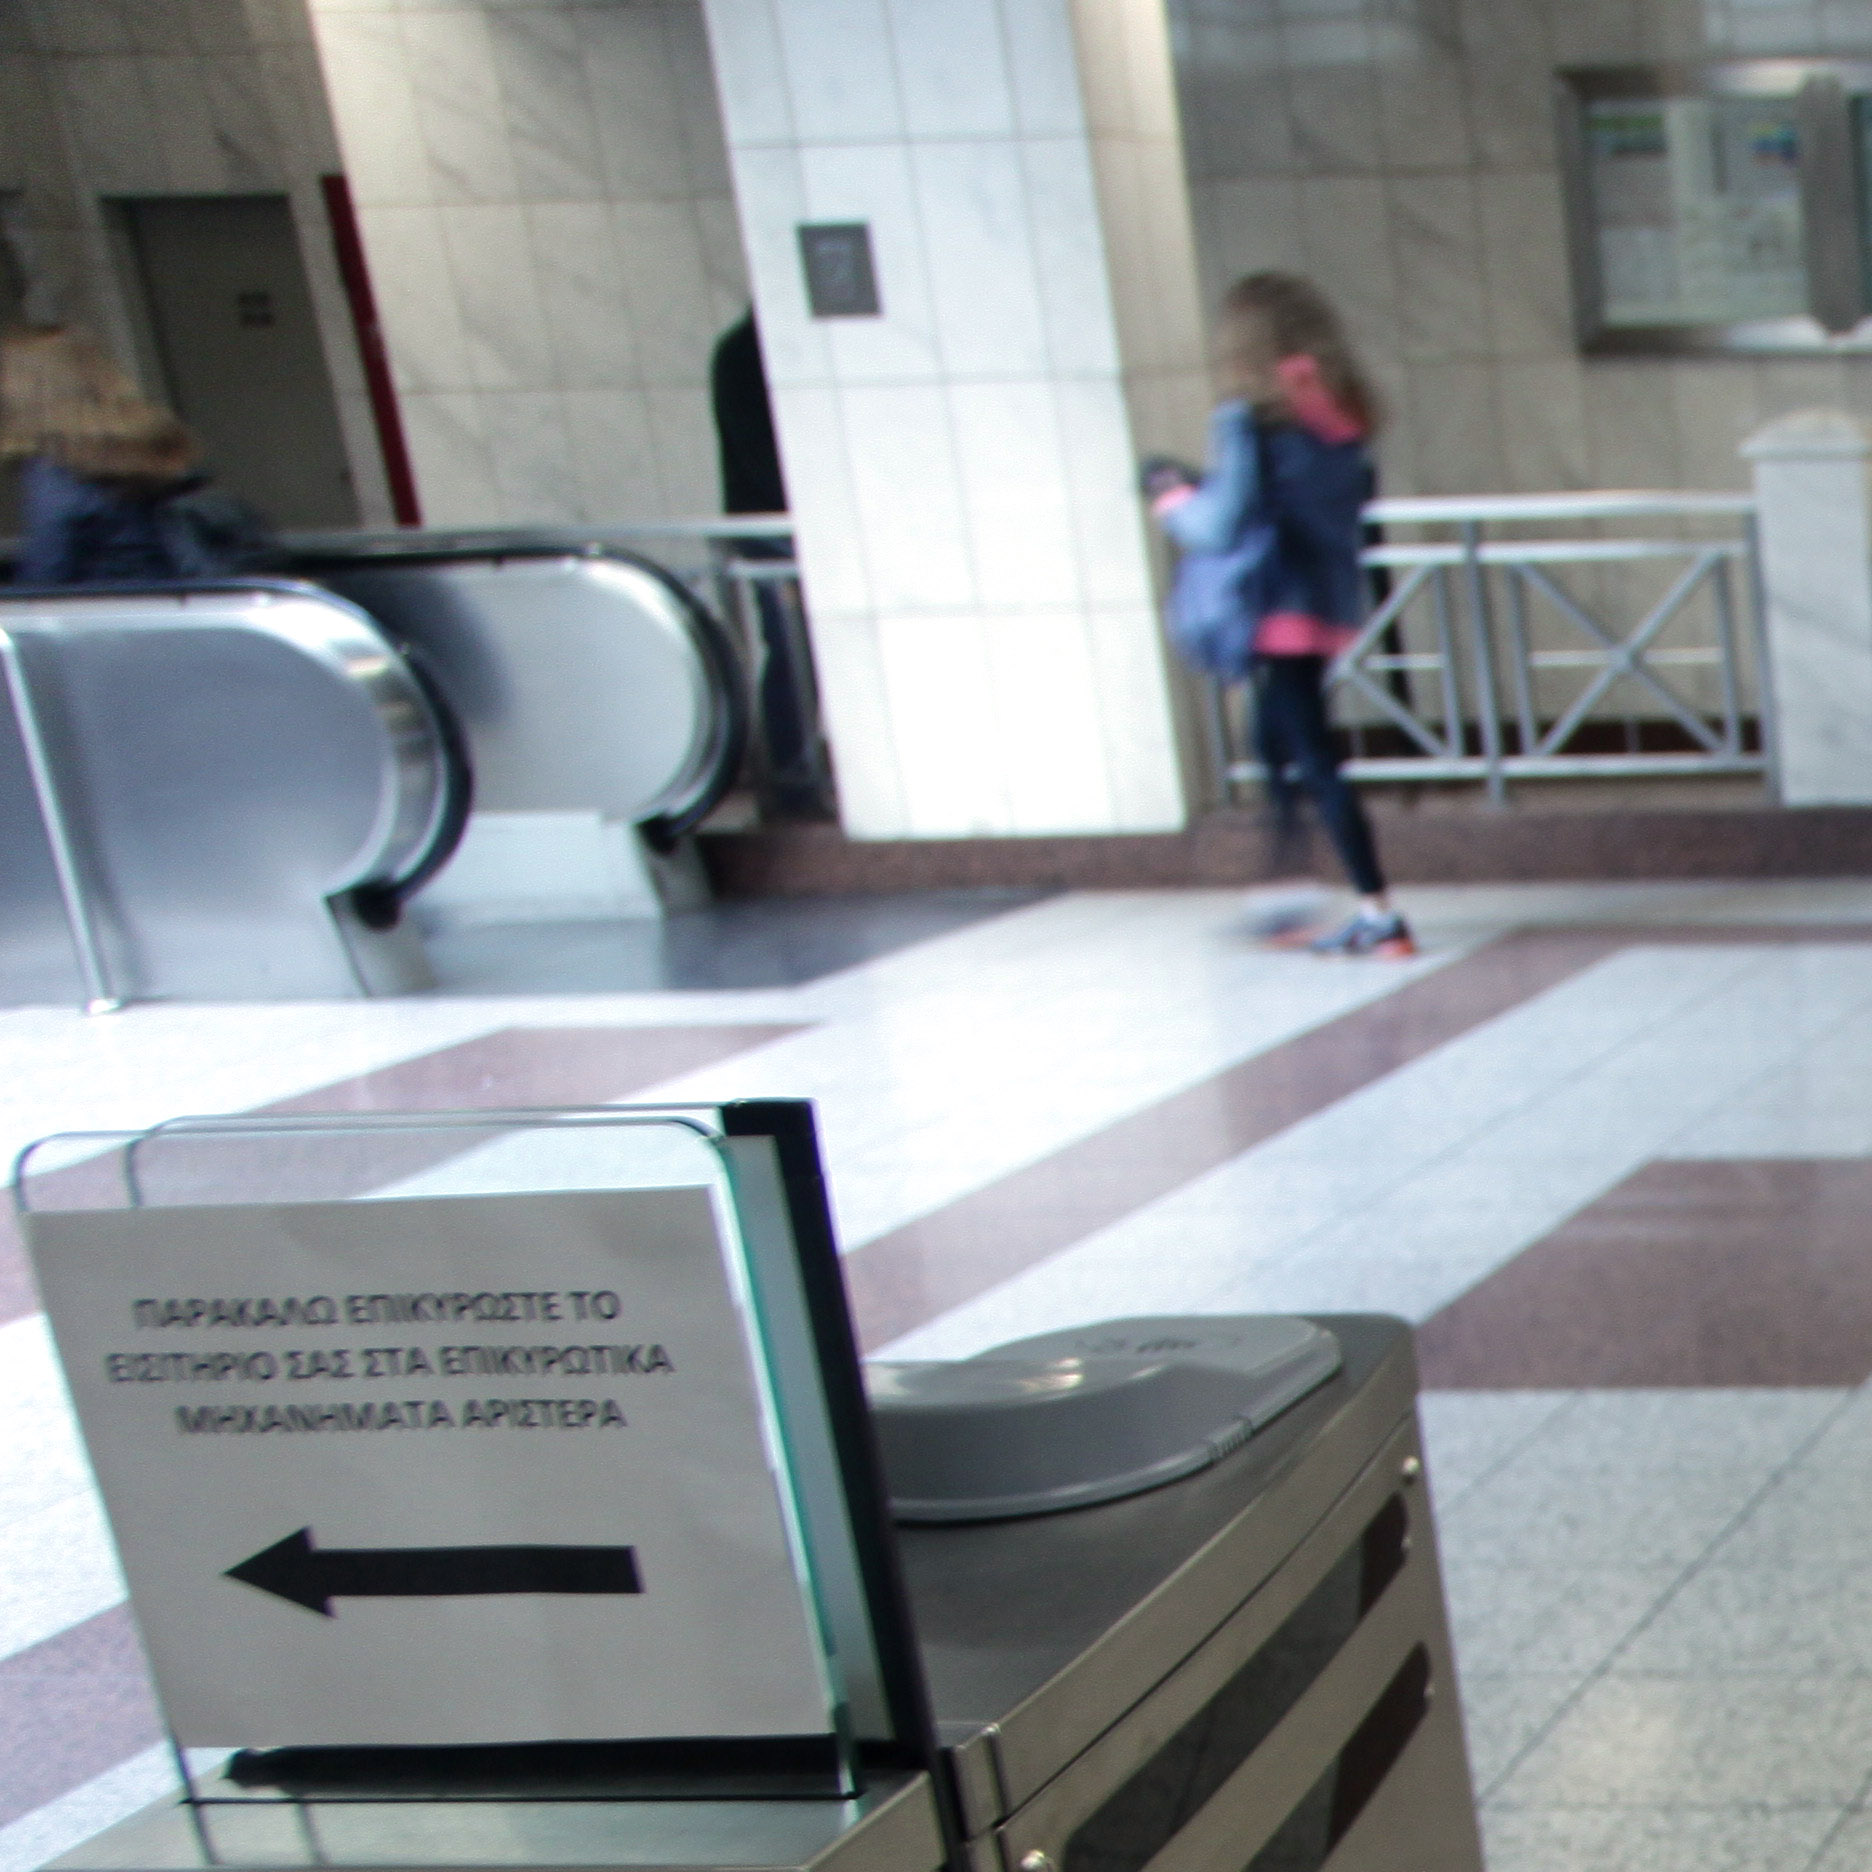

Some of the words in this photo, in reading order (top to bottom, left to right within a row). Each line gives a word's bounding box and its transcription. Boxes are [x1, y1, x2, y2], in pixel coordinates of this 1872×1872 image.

[131, 1297, 338, 1328] ΠΑΡΑΚΑΛΩ
[346, 1292, 563, 1324] ΕΠΙΚΥΡΩΣΤΕ
[568, 1290, 622, 1320] ΤΟ
[104, 1351, 278, 1382] ΕΙΣΙΤΗΡΙΟ
[285, 1349, 355, 1379] ΣΑΣ
[361, 1346, 434, 1377] ΣΤΑ
[439, 1345, 676, 1376] ΕΠΙΚΥΡΩΤΙΚΑ
[175, 1401, 454, 1434] ΜΗΧΑΝΗΜΑΤΑ
[462, 1399, 628, 1430] ΑΡΙΣΤΕΡΑ
